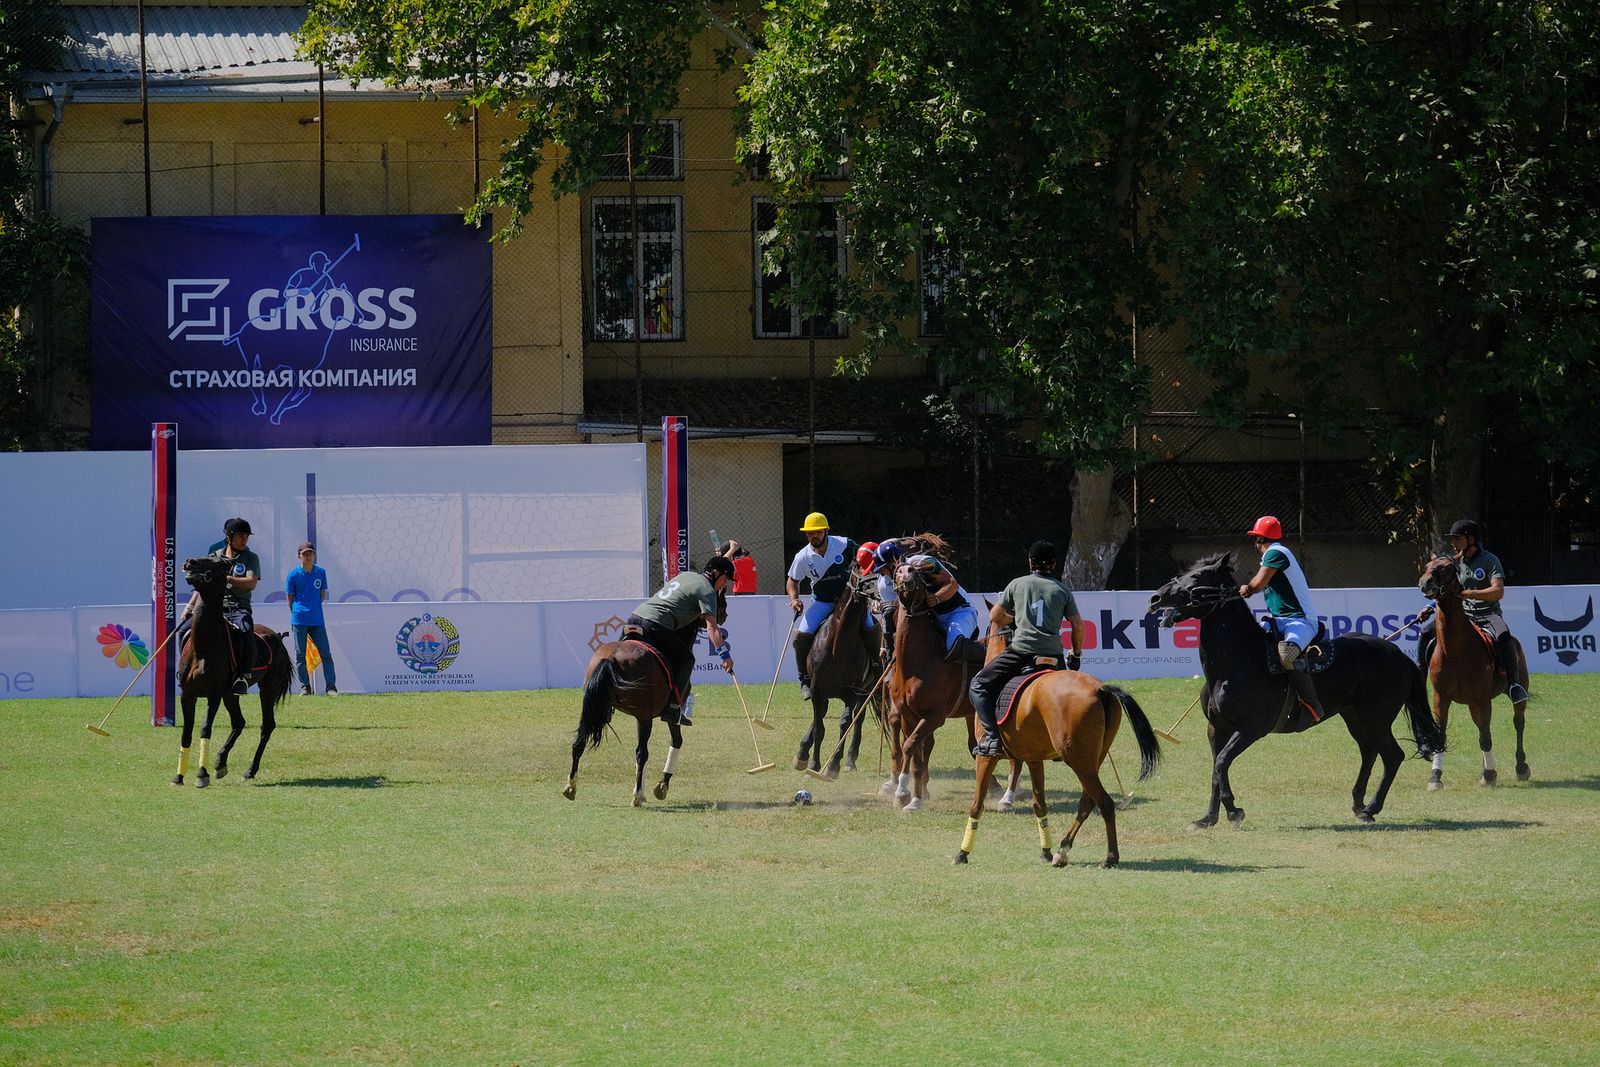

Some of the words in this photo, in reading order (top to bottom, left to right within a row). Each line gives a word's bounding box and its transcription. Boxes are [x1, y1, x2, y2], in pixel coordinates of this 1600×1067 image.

[248, 287, 418, 331] GROSS
[350, 338, 418, 352] INSURANCE
[169, 369, 294, 388] СТРАХОВАЯ
[299, 368, 417, 388] КОМПАНИЯ
[677, 550, 687, 573] POL
[164, 560, 174, 588] POLO
[658, 581, 681, 600] 3
[1030, 598, 1045, 627] 1
[1537, 634, 1597, 655] BUKA
[1081, 657, 1116, 665] GROUP
[1133, 656, 1192, 664] COMPANIES
